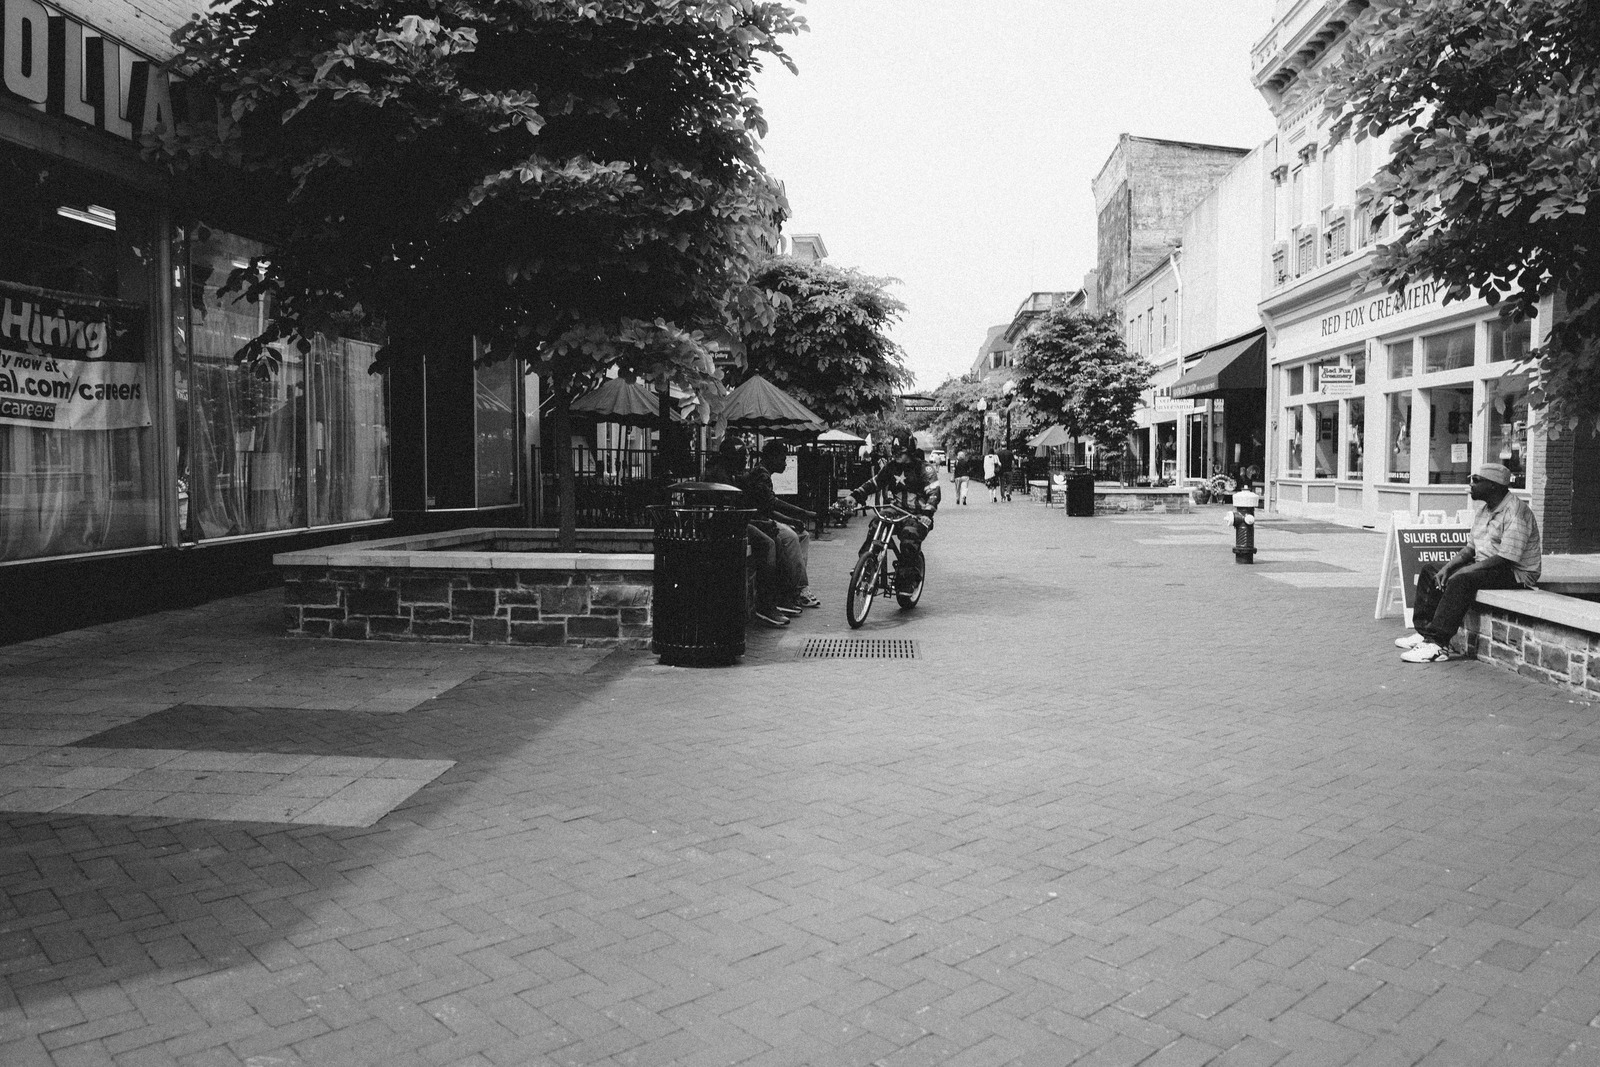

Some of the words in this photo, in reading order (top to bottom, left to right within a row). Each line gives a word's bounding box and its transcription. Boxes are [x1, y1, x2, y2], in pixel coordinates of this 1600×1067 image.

[1321, 314, 1341, 337] RED
[1345, 306, 1365, 330] FOX
[1369, 281, 1440, 322] CREAMERY
[1, 297, 108, 359] Hiring
[14, 356, 42, 371] now
[45, 360, 60, 373] at
[1, 401, 55, 419] careers
[893, 437, 900, 446] A
[1403, 532, 1438, 543] SILVER
[1417, 551, 1459, 562] JEWELR
